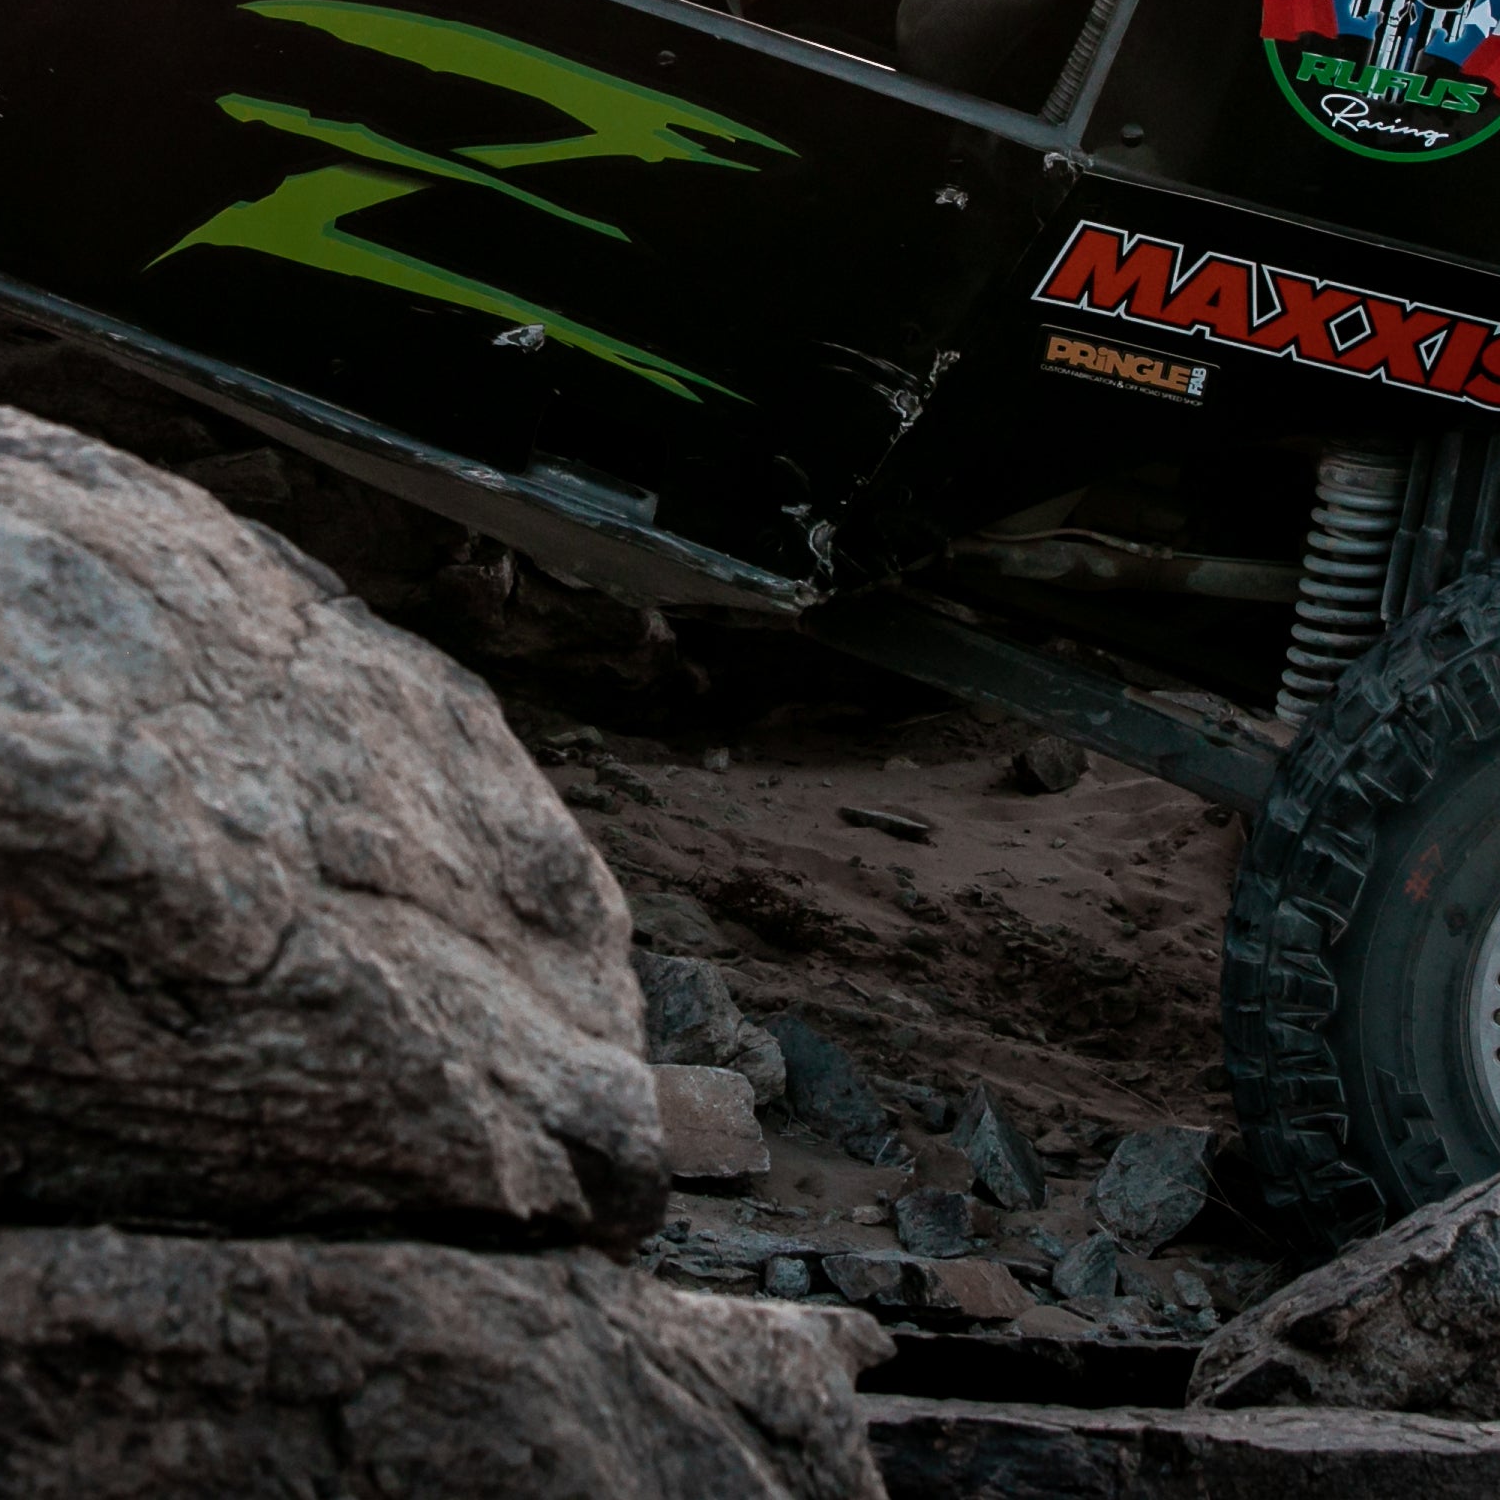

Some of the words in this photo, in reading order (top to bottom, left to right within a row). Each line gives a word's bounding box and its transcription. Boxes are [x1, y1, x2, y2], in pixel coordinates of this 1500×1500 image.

[1296, 51, 1488, 114] RUFUS
[1320, 93, 1450, 148] Racing
[1040, 363, 1071, 376] CUSTOM
[1071, 369, 1117, 388] FABRICATION
[1116, 380, 1124, 390] &
[1139, 387, 1161, 398] ROAD
[1161, 391, 1184, 404] SPEED
[1183, 396, 1204, 408] SHOP
[1187, 367, 1207, 397] FAB
